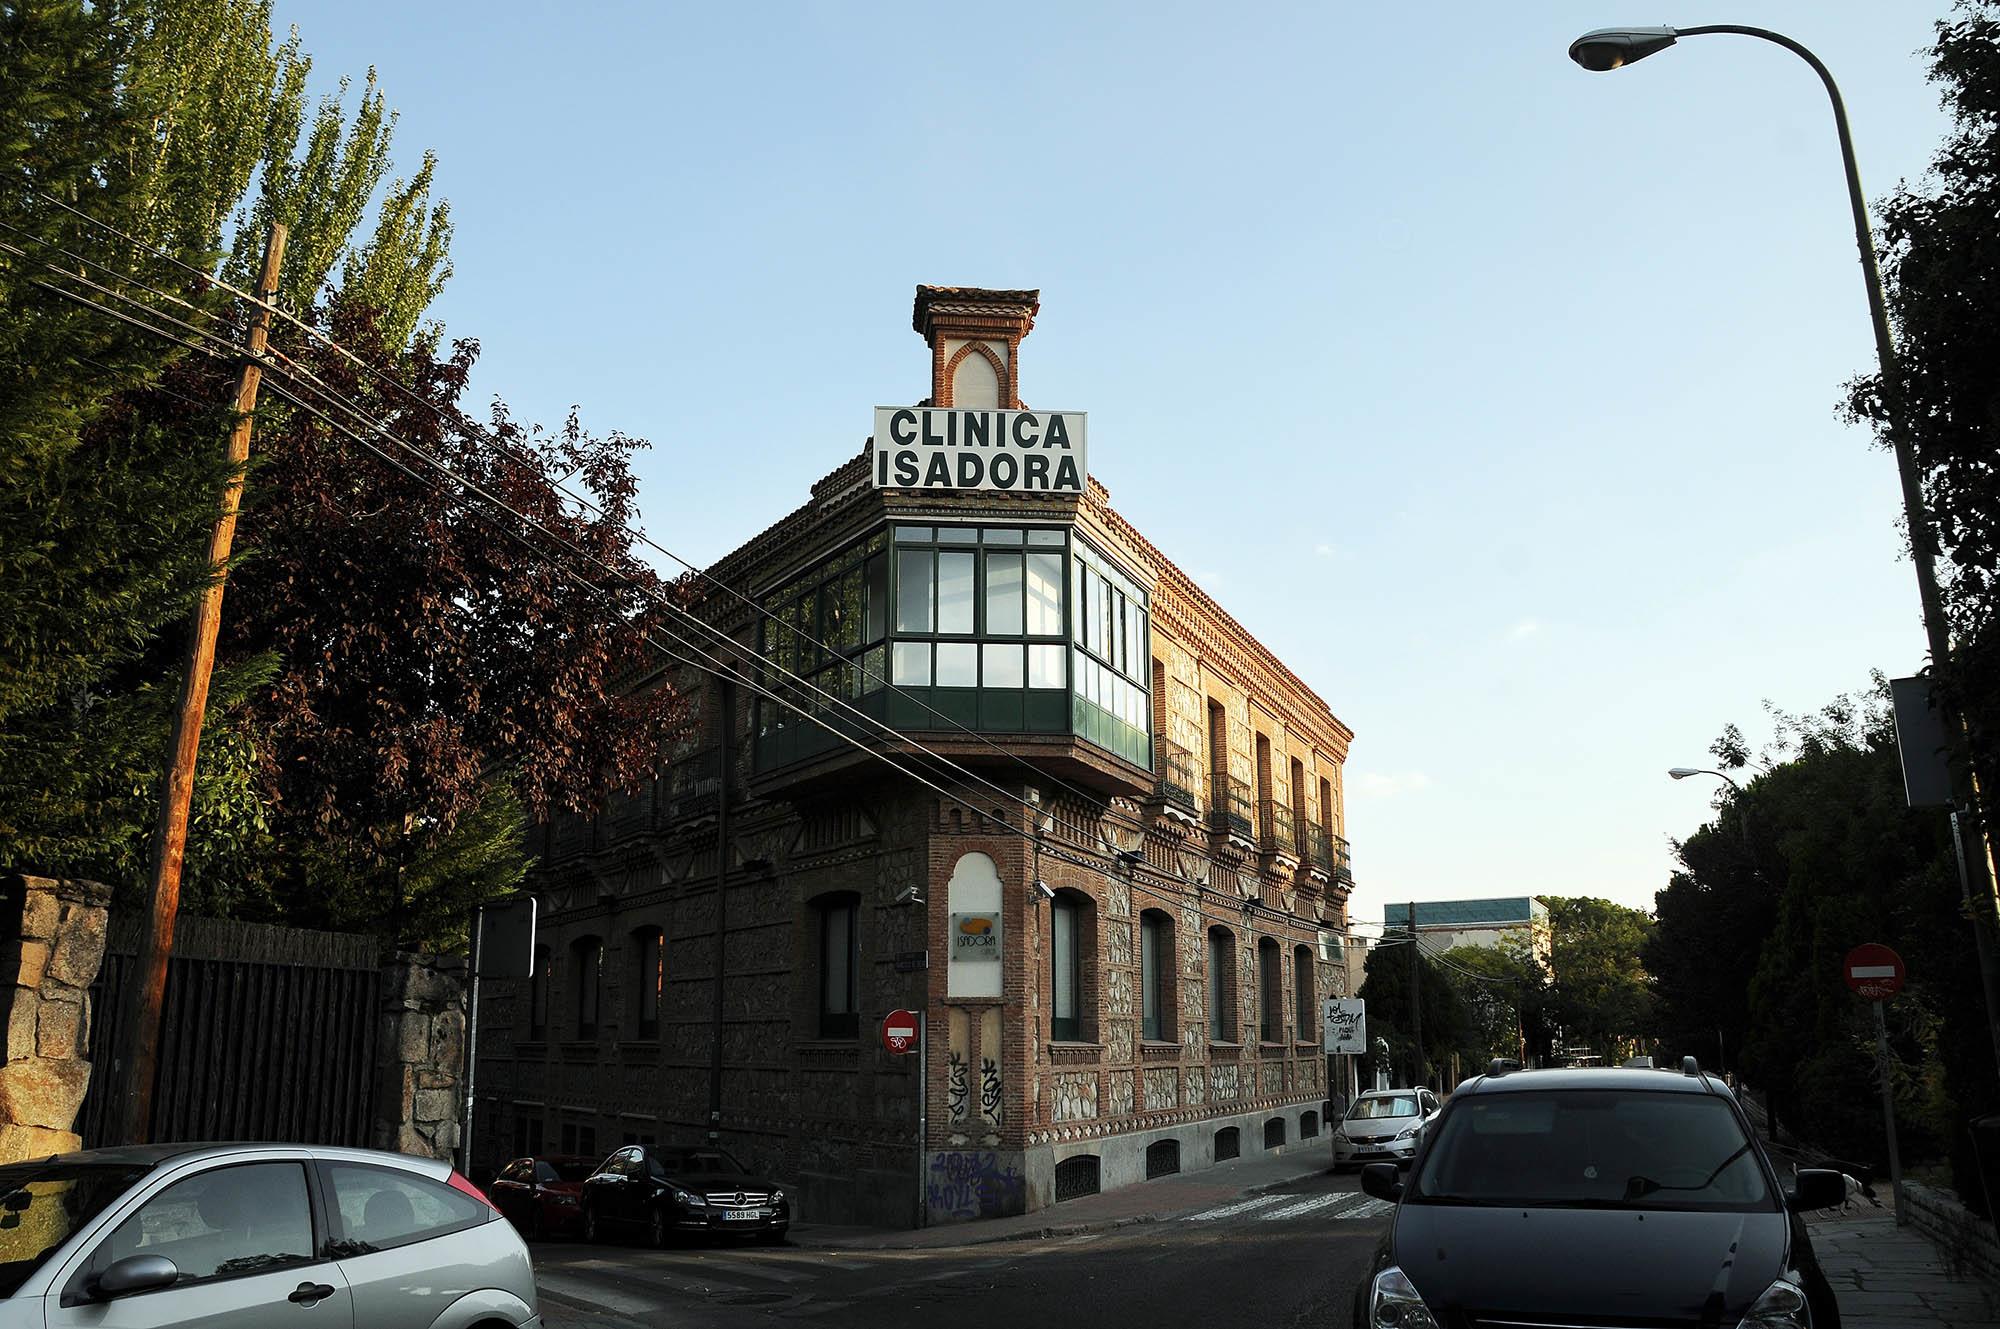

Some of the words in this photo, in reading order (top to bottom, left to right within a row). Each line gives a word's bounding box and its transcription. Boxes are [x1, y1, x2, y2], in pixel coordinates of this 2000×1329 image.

[889, 409, 1071, 450] CLINICA
[878, 450, 1082, 490] ISADORA
[957, 935, 996, 947] ISADORA
[727, 1211, 745, 1219] 5589
